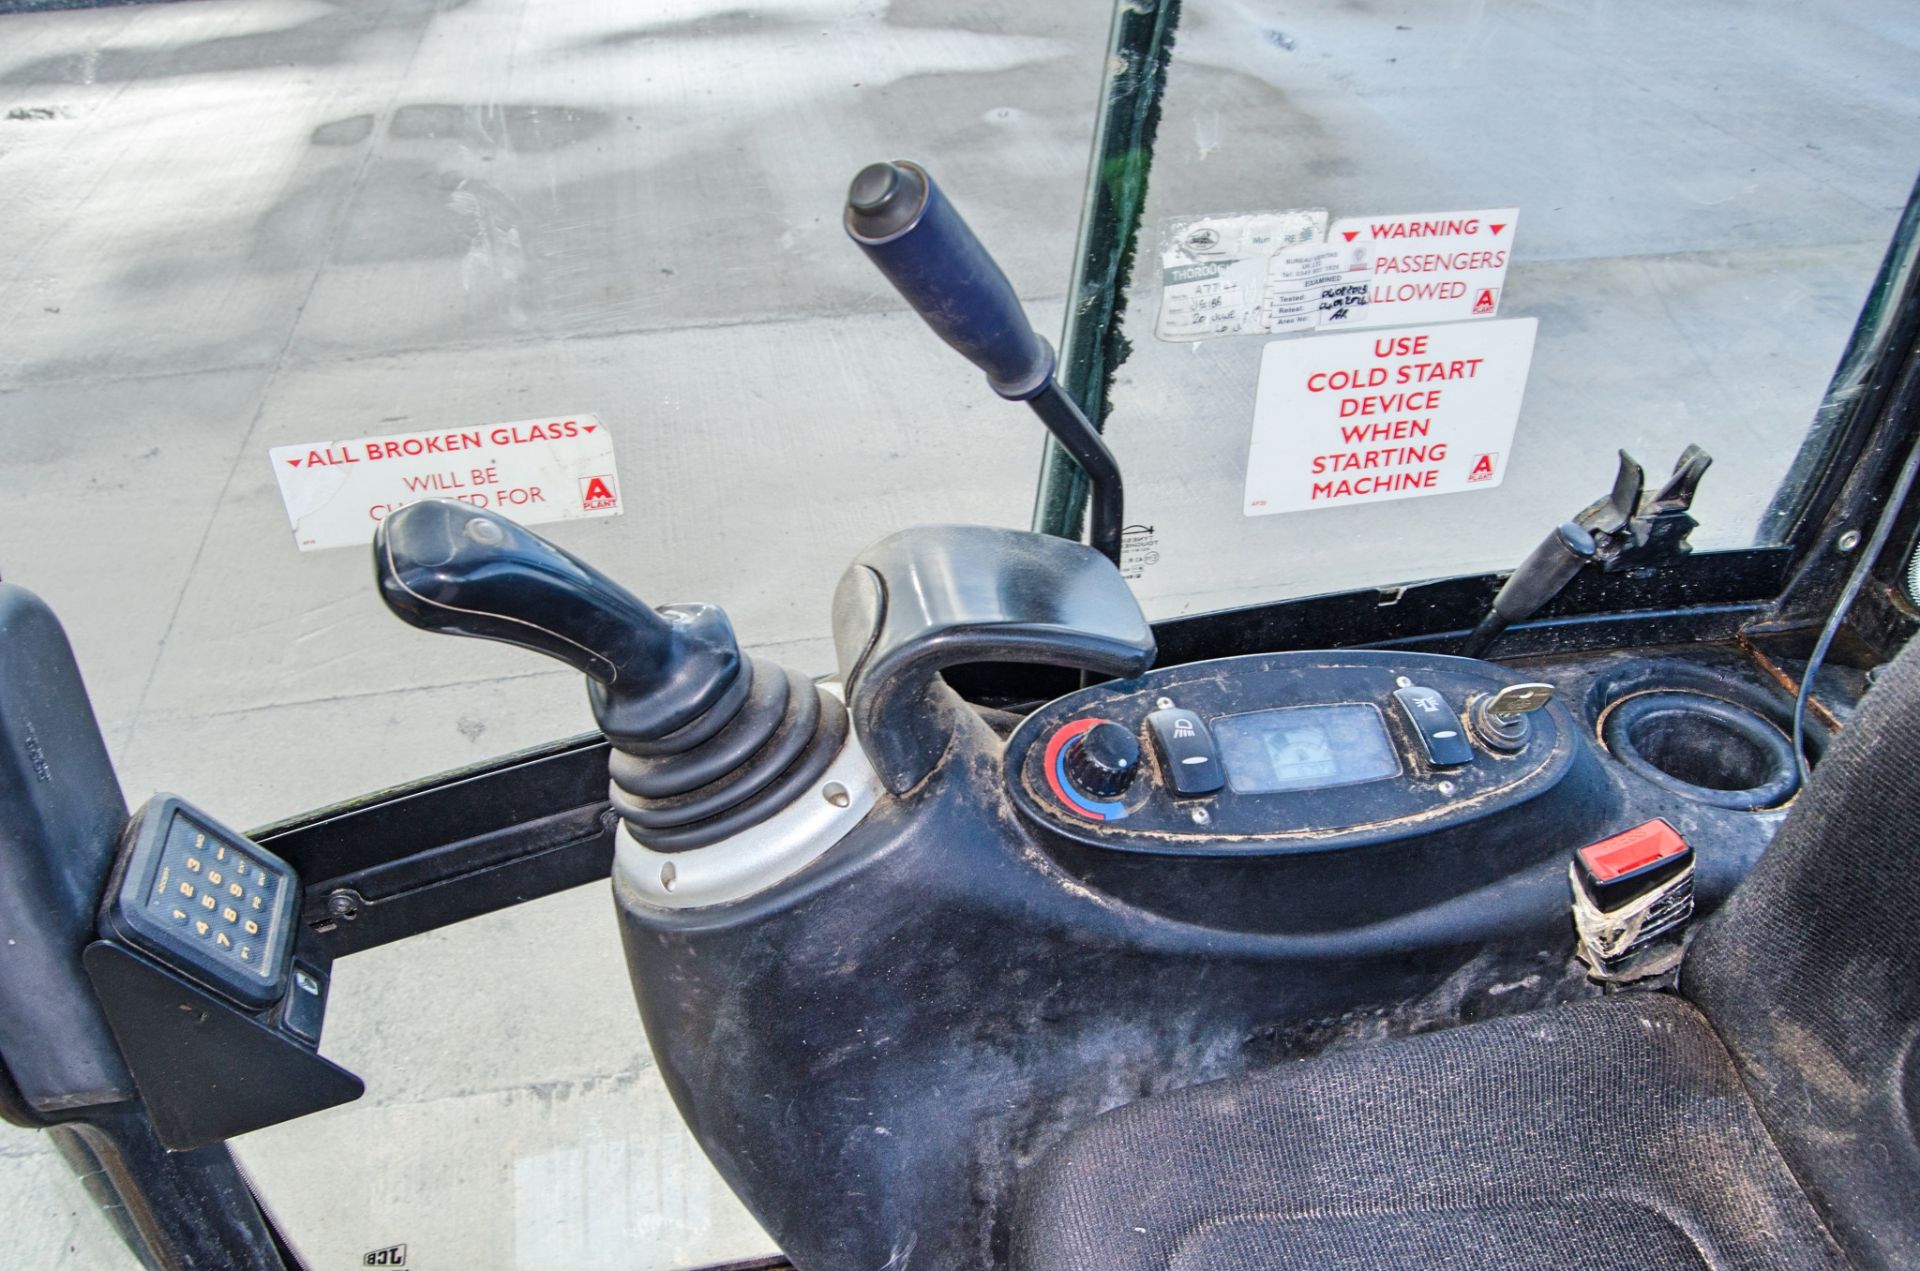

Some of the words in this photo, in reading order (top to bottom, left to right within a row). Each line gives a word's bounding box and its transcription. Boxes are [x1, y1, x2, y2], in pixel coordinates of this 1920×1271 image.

[1371, 219, 1479, 239] WARNING
[1375, 251, 1505, 274] PASSENGERS
[1304, 275, 1342, 287] EXAMINED
[1476, 290, 1493, 306] A
[1374, 336, 1428, 357] USE
[1306, 368, 1387, 392] COLD
[1396, 359, 1483, 384] START
[1339, 391, 1441, 417] DEVICE
[1341, 419, 1431, 444] WHEN
[307, 447, 359, 468] ALL
[366, 432, 482, 460] BROKEN
[491, 421, 579, 446] GLASS
[1311, 443, 1448, 474] STARTING
[1473, 455, 1491, 473] A
[402, 472, 464, 492] WILL
[471, 467, 499, 485] BE
[585, 477, 613, 500] A
[1311, 470, 1439, 499] MACHINE
[496, 486, 547, 507] FOR
[173, 909, 186, 919] 1
[180, 882, 194, 897] 2
[187, 857, 200, 872] 3
[208, 870, 222, 885] 6
[229, 883, 242, 897] 9
[202, 895, 215, 910] 5
[223, 907, 237, 922] 8
[196, 921, 208, 935] 4
[216, 932, 230, 946] 7
